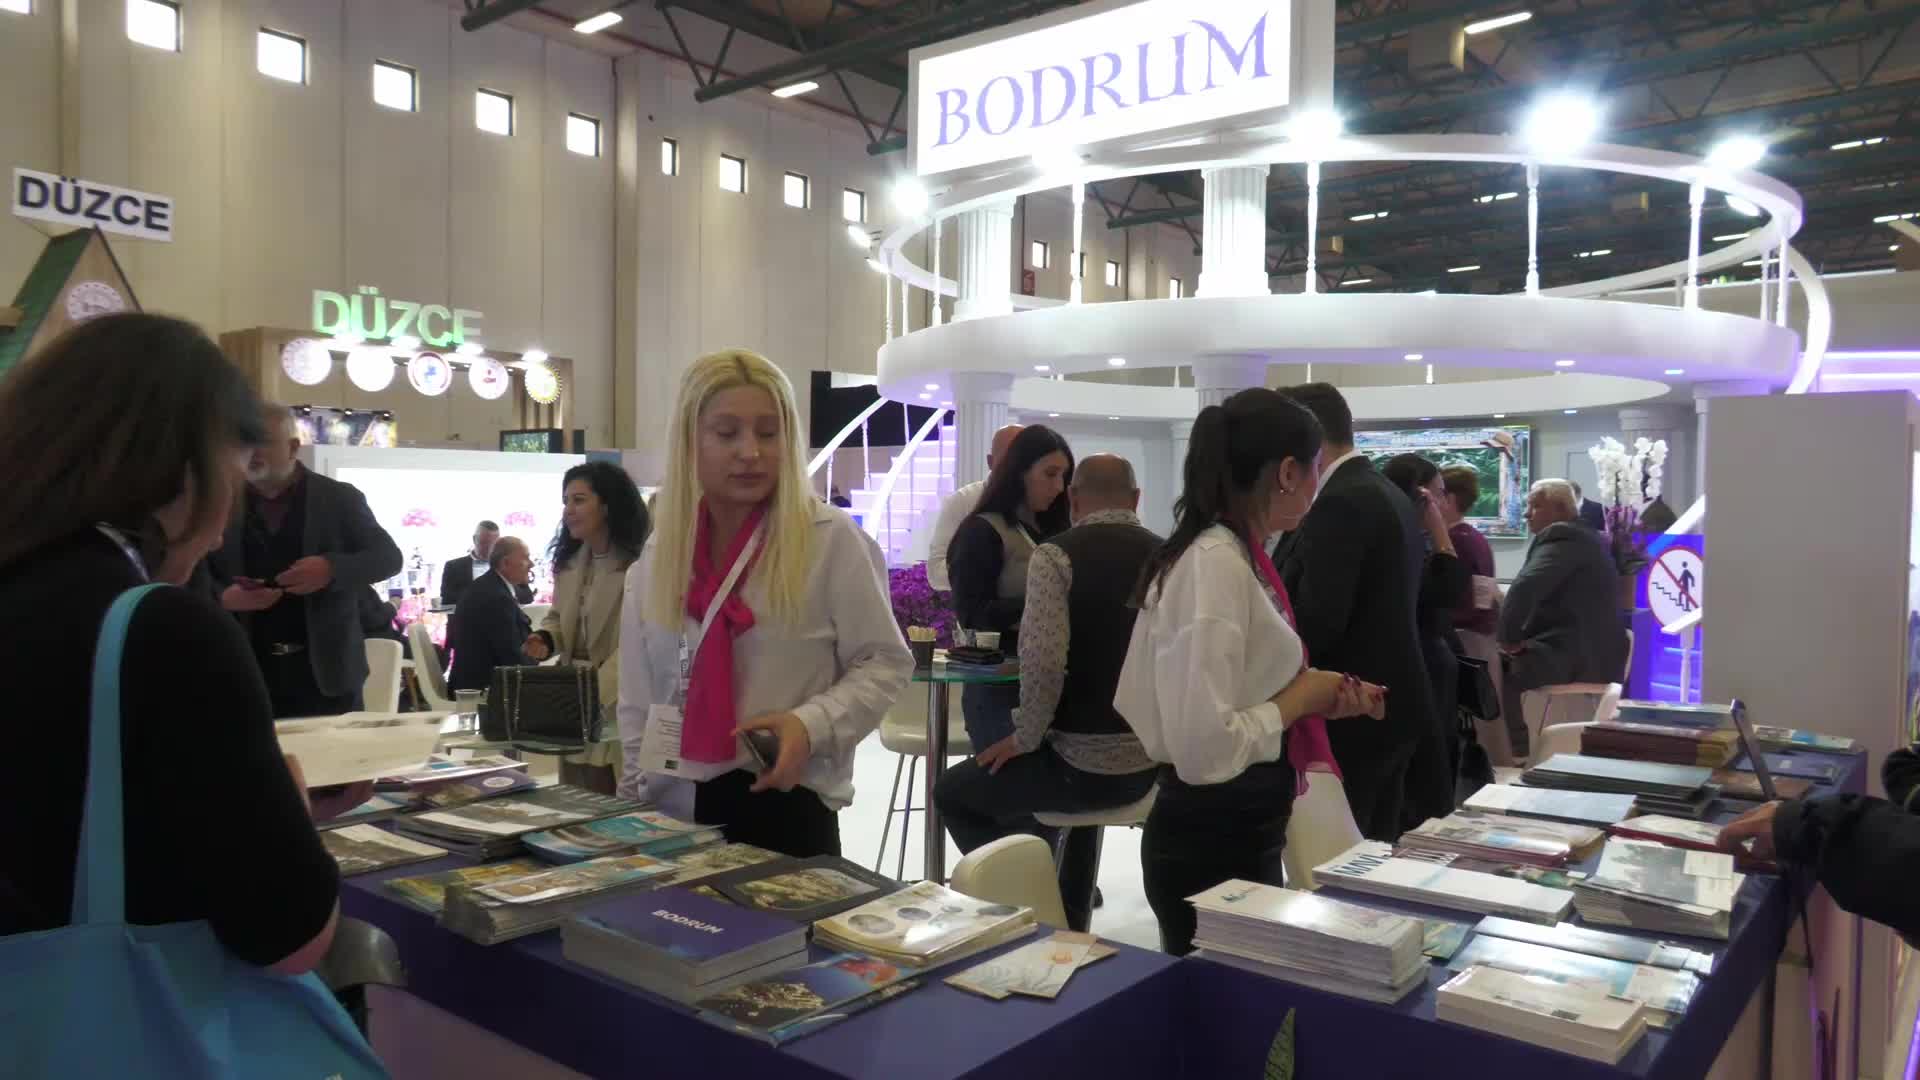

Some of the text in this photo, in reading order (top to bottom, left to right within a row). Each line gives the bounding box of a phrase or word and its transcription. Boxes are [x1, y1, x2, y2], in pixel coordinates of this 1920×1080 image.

[931, 11, 1272, 148] BODRUM
[19, 175, 170, 232] DÜZCE
[312, 284, 484, 348] DÜZCE
[651, 909, 724, 934] BODRUM
